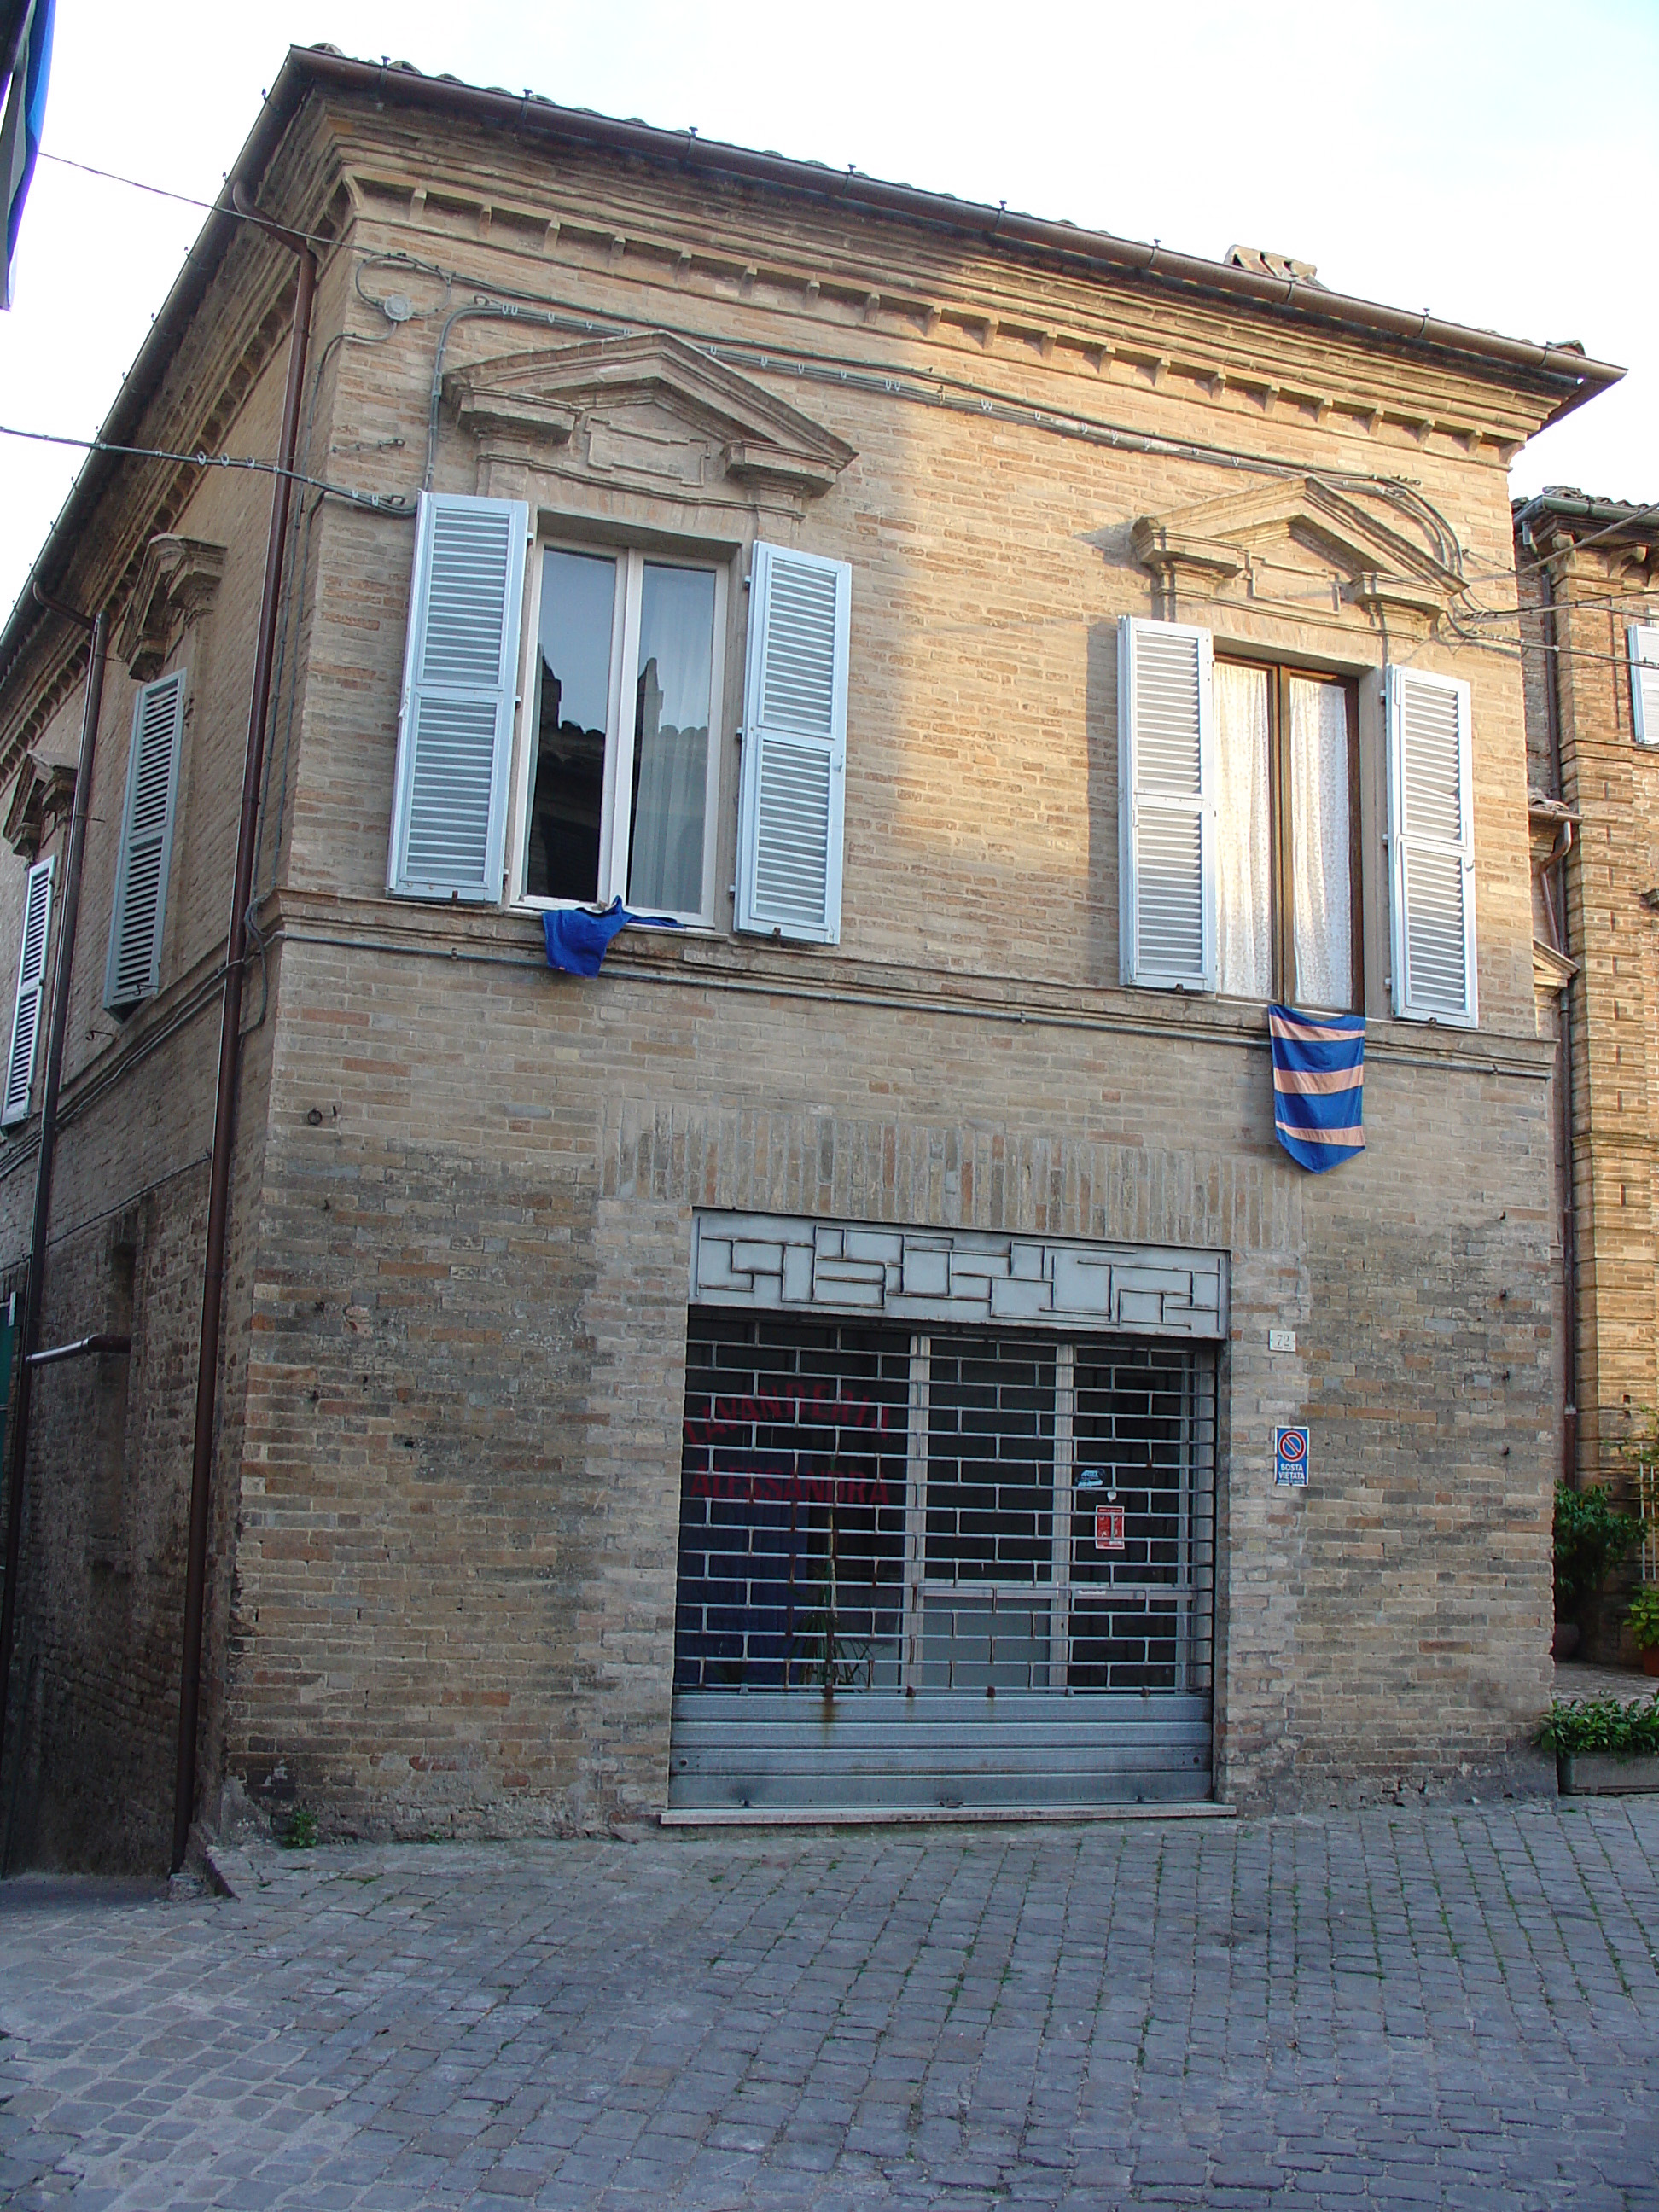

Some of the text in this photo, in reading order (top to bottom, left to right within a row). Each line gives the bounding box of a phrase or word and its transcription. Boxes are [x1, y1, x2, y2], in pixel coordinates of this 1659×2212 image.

[1277, 1334, 1289, 1347] 72
[684, 1382, 890, 1444] LAVANDERIA
[1280, 1463, 1303, 1471] SOSTA
[1278, 1471, 1305, 1480] VIETATA
[690, 1464, 889, 1505] ALESSANDRA
